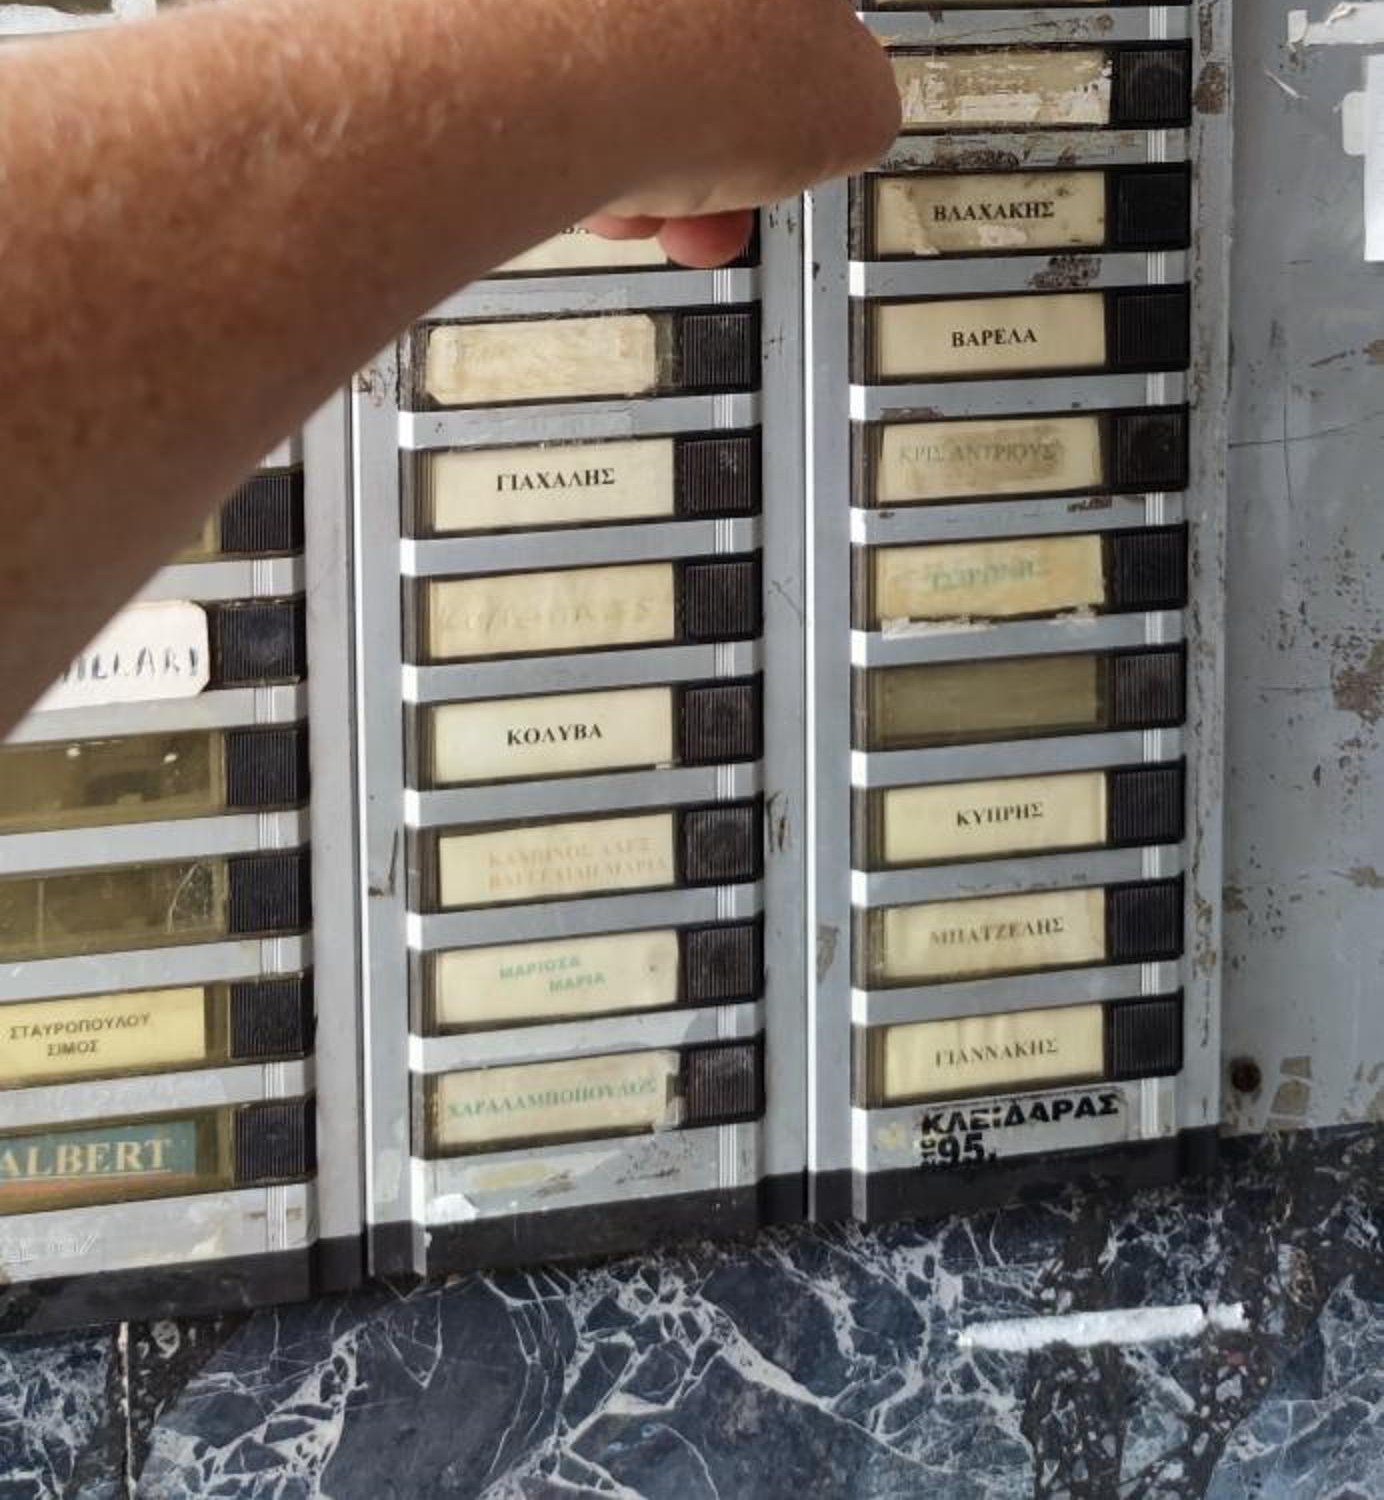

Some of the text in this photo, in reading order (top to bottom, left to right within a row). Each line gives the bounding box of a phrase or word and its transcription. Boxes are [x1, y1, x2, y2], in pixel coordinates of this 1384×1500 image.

[934, 201, 1054, 222] ΒΛΑΧΑΚΗΣ
[952, 328, 1038, 348] ΒΑΡΕΛΑ
[497, 467, 615, 492] ΓΙΑΧΑΛΗΣ
[507, 723, 602, 746] ΚΟΛΥΒΑ
[956, 803, 1043, 826] ΚΥΠΡΗΣ
[931, 917, 1064, 945] ΜΠΑΤΖΕΛΗΣ
[10, 1013, 150, 1040] ΣΤΑΥΡΟΠΟΥΛΟΥ
[47, 1040, 98, 1057] ΣΙΜΟΣ
[935, 1039, 1058, 1066] ΓΙΑΝΝΑΚΗΣ
[921, 1093, 1119, 1135] ΚΛΕΙΔΑΡΑΣ
[0, 1138, 172, 1178] ALBERT
